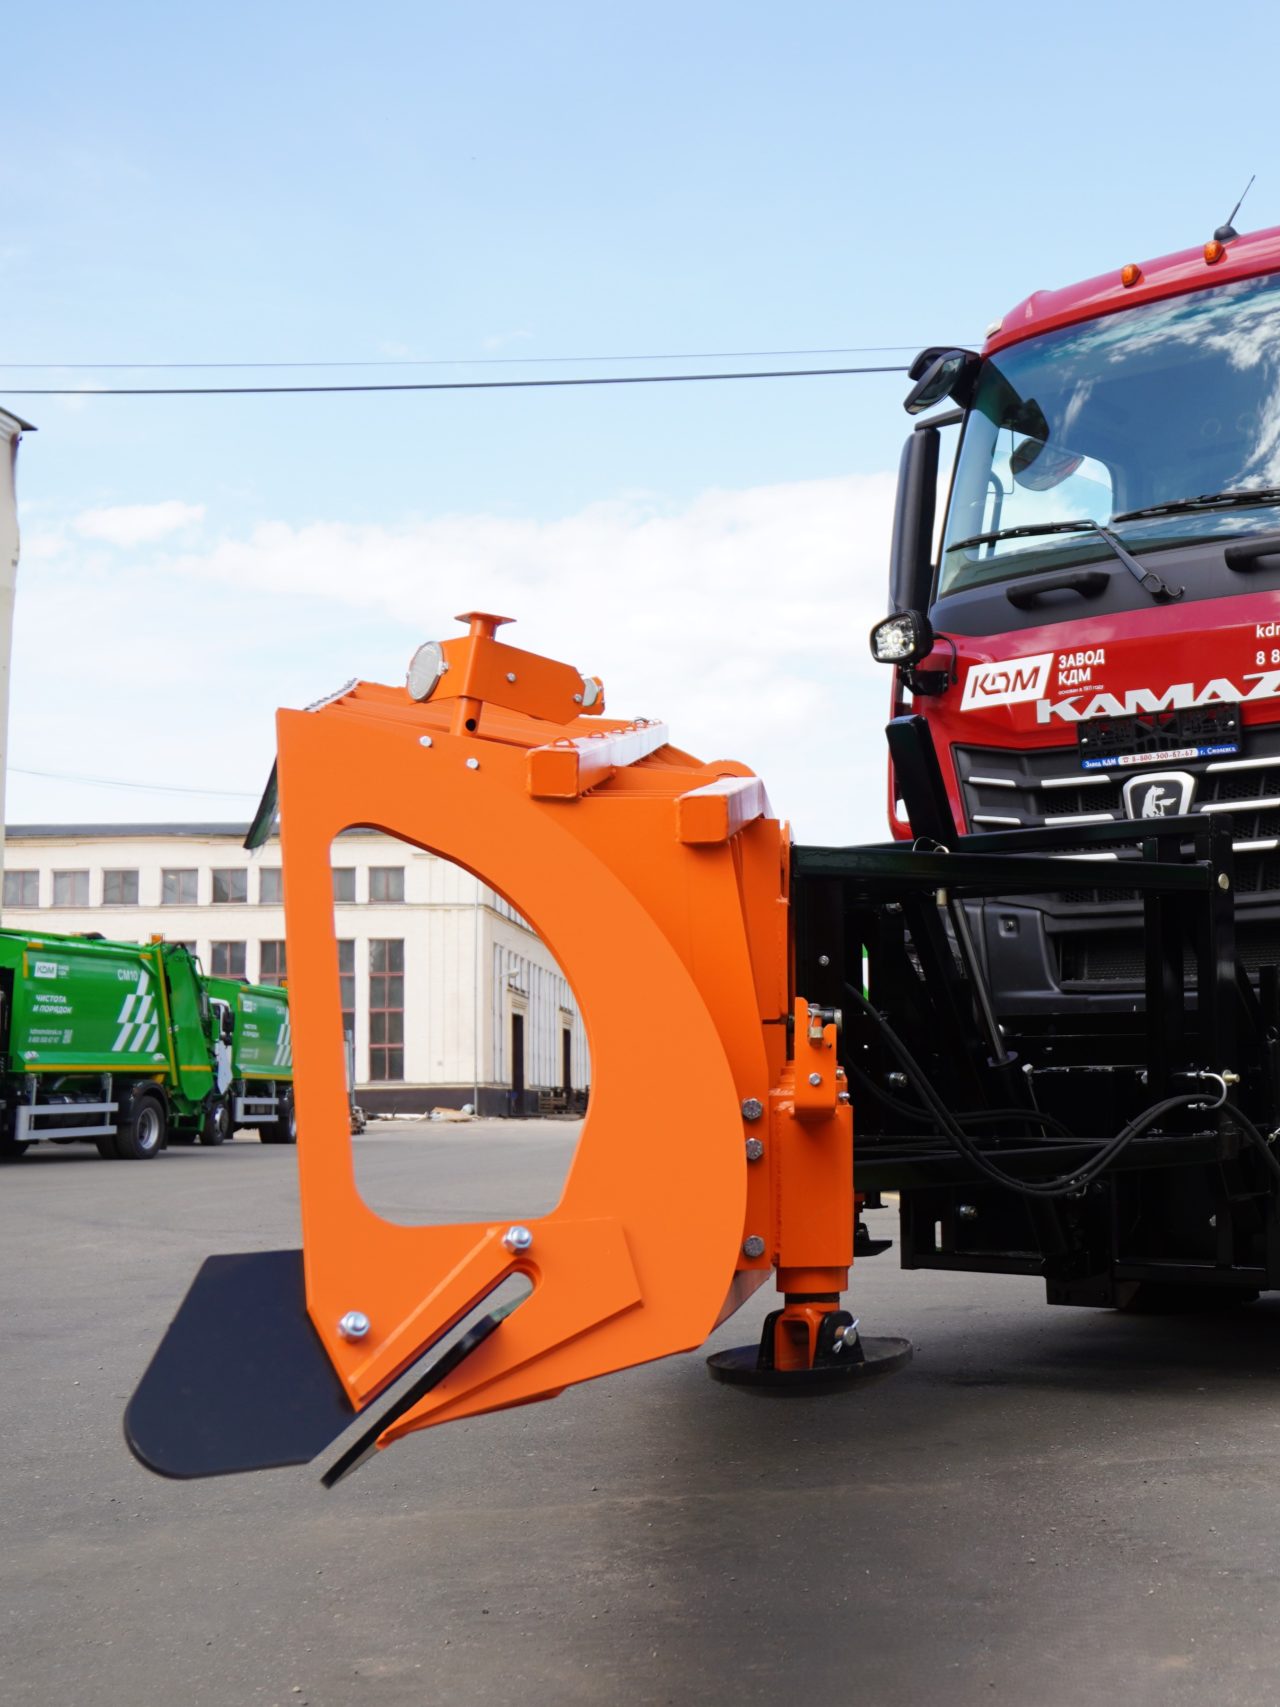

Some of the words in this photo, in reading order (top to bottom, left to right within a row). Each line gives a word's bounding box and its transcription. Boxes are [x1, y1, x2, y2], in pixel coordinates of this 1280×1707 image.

[1058, 648, 1105, 669] ЗАВОД
[1256, 650, 1265, 665] 8
[971, 665, 1041, 698] KDM
[1058, 667, 1091, 686] КДМ
